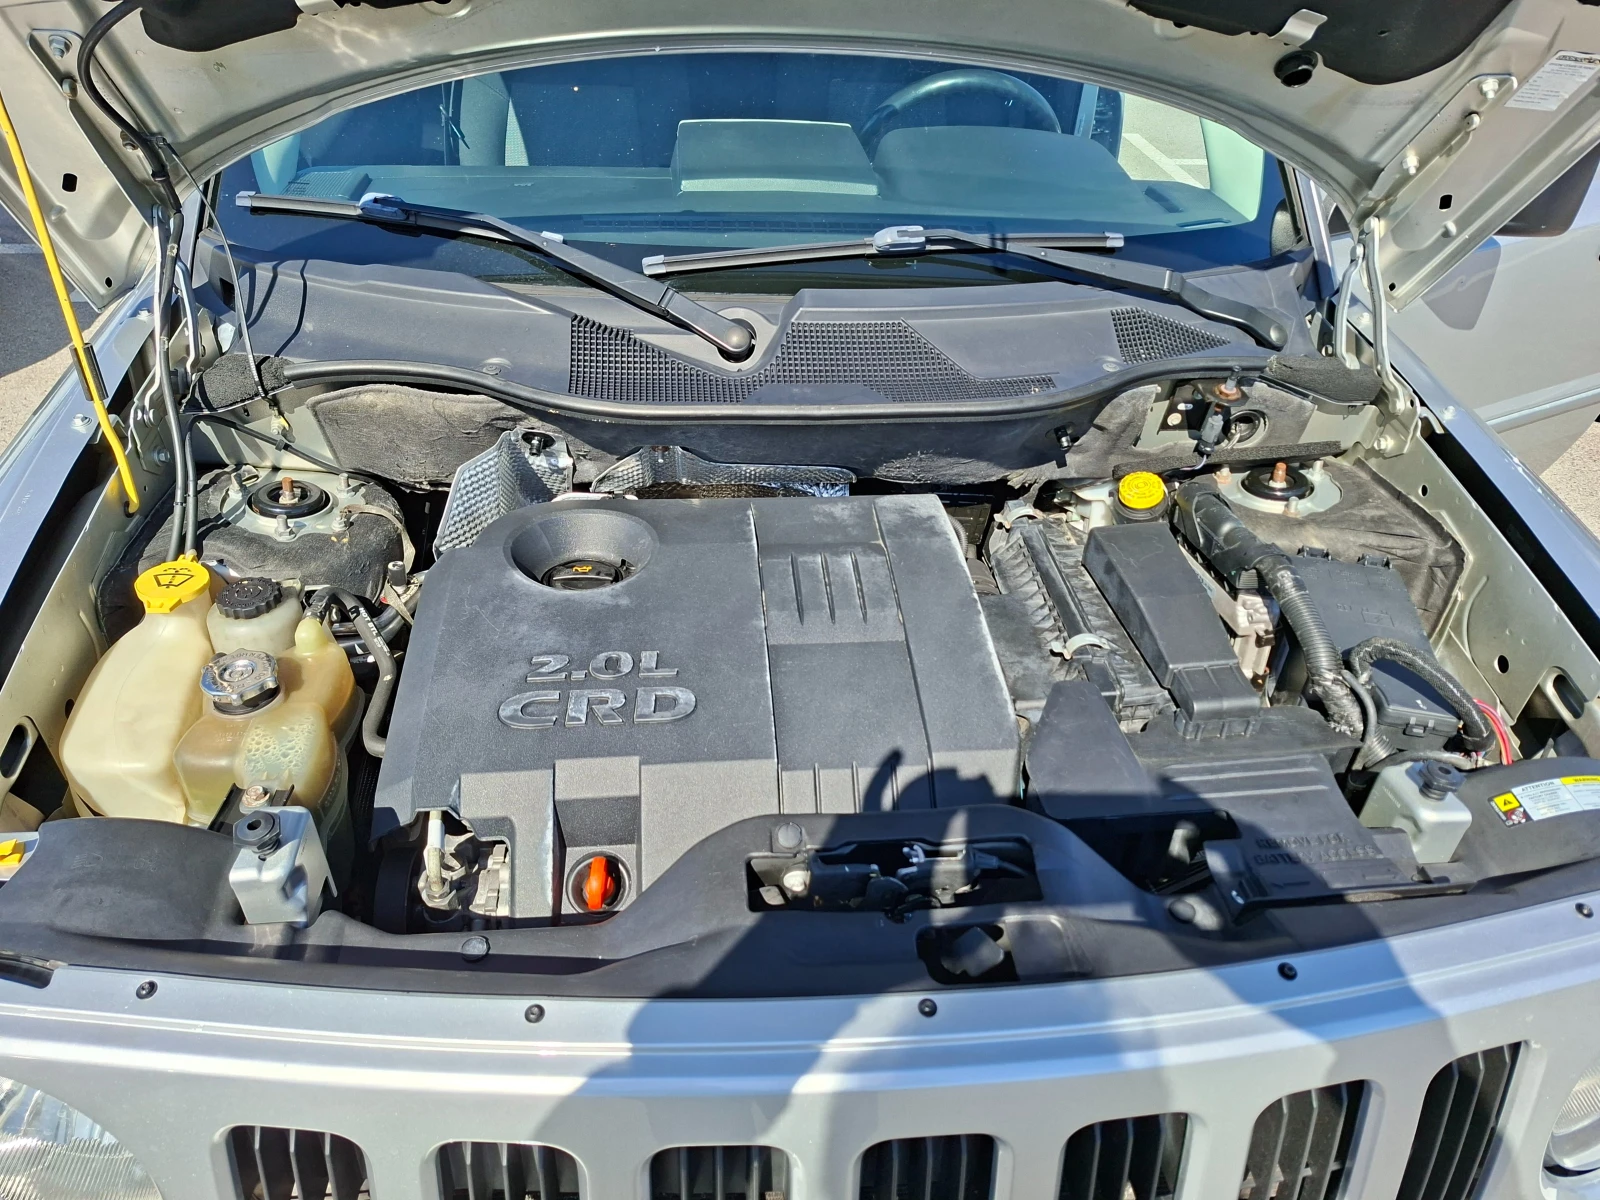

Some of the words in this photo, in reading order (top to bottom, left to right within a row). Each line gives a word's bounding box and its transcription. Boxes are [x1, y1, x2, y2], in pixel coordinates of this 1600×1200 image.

[526, 650, 678, 682] 2.0L
[498, 686, 697, 729] CRD
[1521, 781, 1555, 792] ATTENTION
[1255, 836, 1315, 849] REMOVE
[1254, 851, 1314, 865] BATTERY
[1320, 844, 1377, 861] ACCESS
